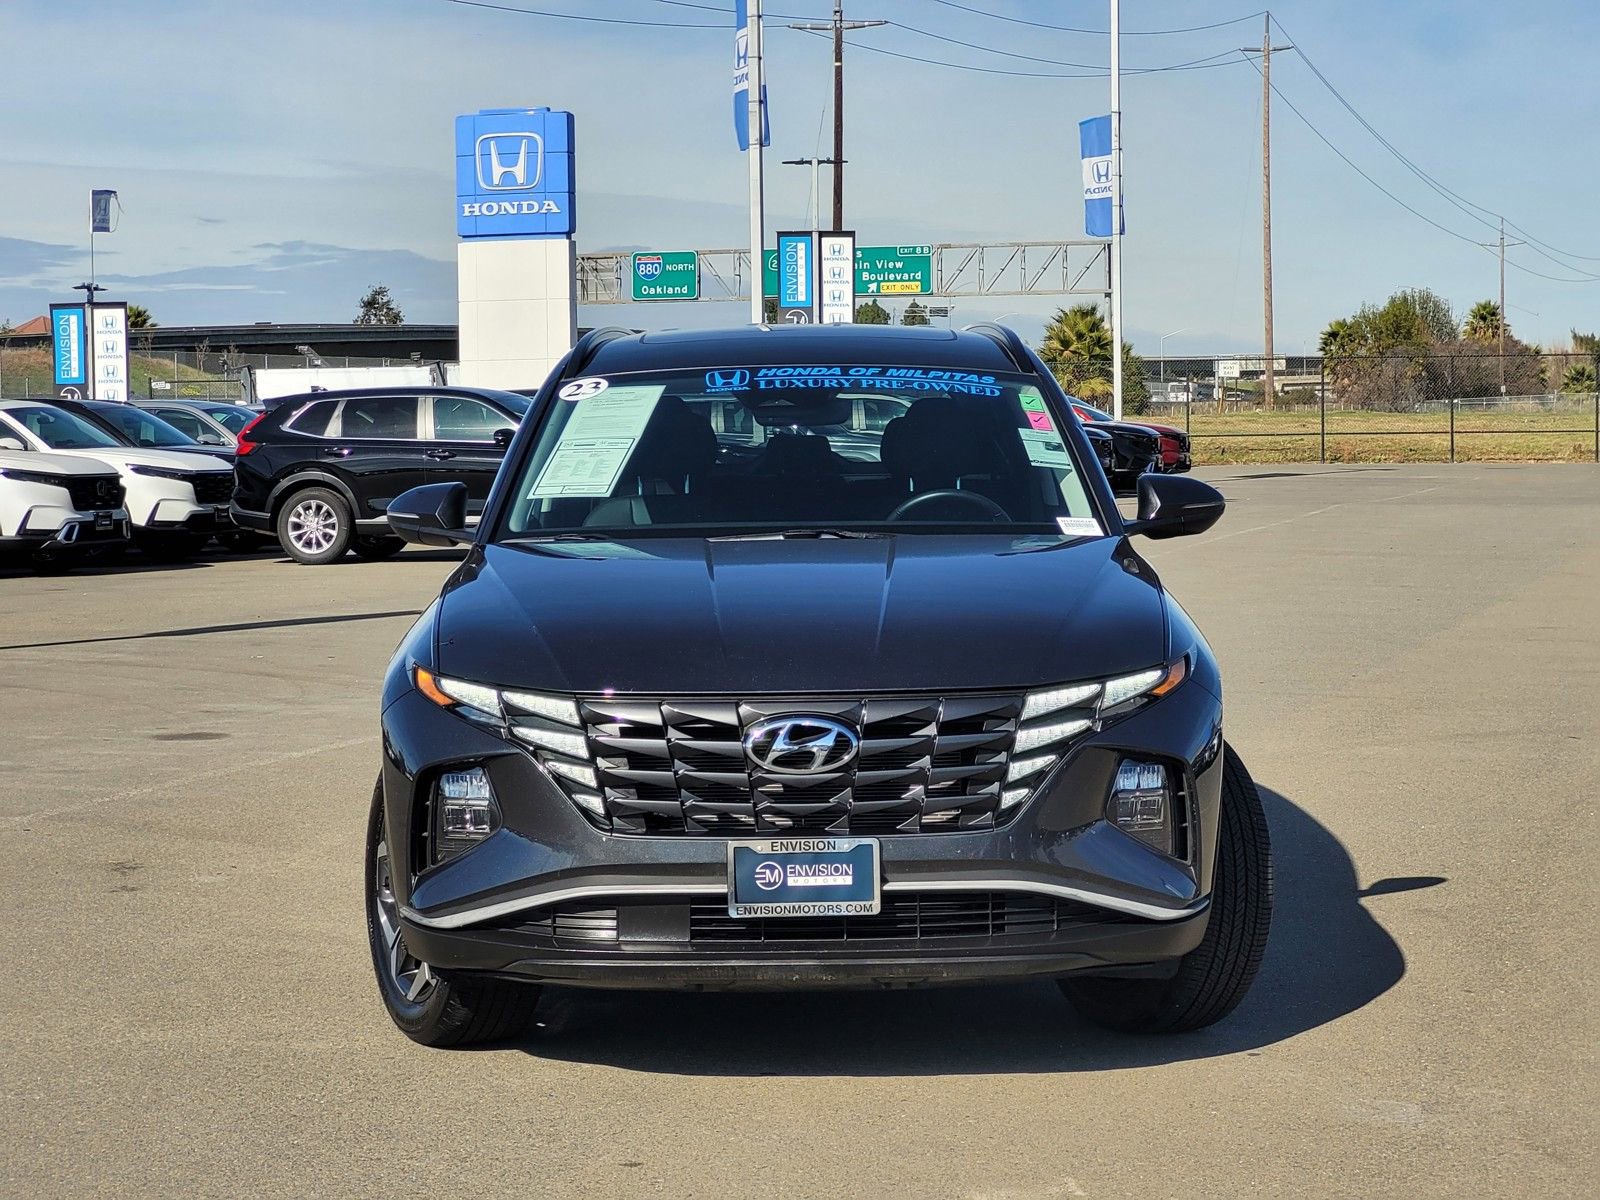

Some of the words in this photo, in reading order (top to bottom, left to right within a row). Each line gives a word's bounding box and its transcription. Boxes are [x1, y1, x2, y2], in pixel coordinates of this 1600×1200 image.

[463, 200, 561, 217] HONDA
[639, 263, 660, 275] 880
[665, 263, 695, 271] NORTH
[875, 259, 904, 269] View
[786, 242, 798, 302] ENVISION
[862, 271, 922, 281] Boulevard
[641, 284, 688, 295] Oakland
[59, 314, 71, 379] ENVISION
[757, 367, 842, 377] HONDA
[849, 367, 882, 376] OF
[885, 368, 996, 384] MILPITAS
[564, 381, 602, 398] 23
[757, 379, 856, 389] LUXURY
[861, 379, 1001, 397] PRE-OWNED
[770, 840, 837, 852] ENVISION
[787, 863, 853, 877] ENVISION
[736, 903, 873, 916] ENVISIONMOTORS.COM
